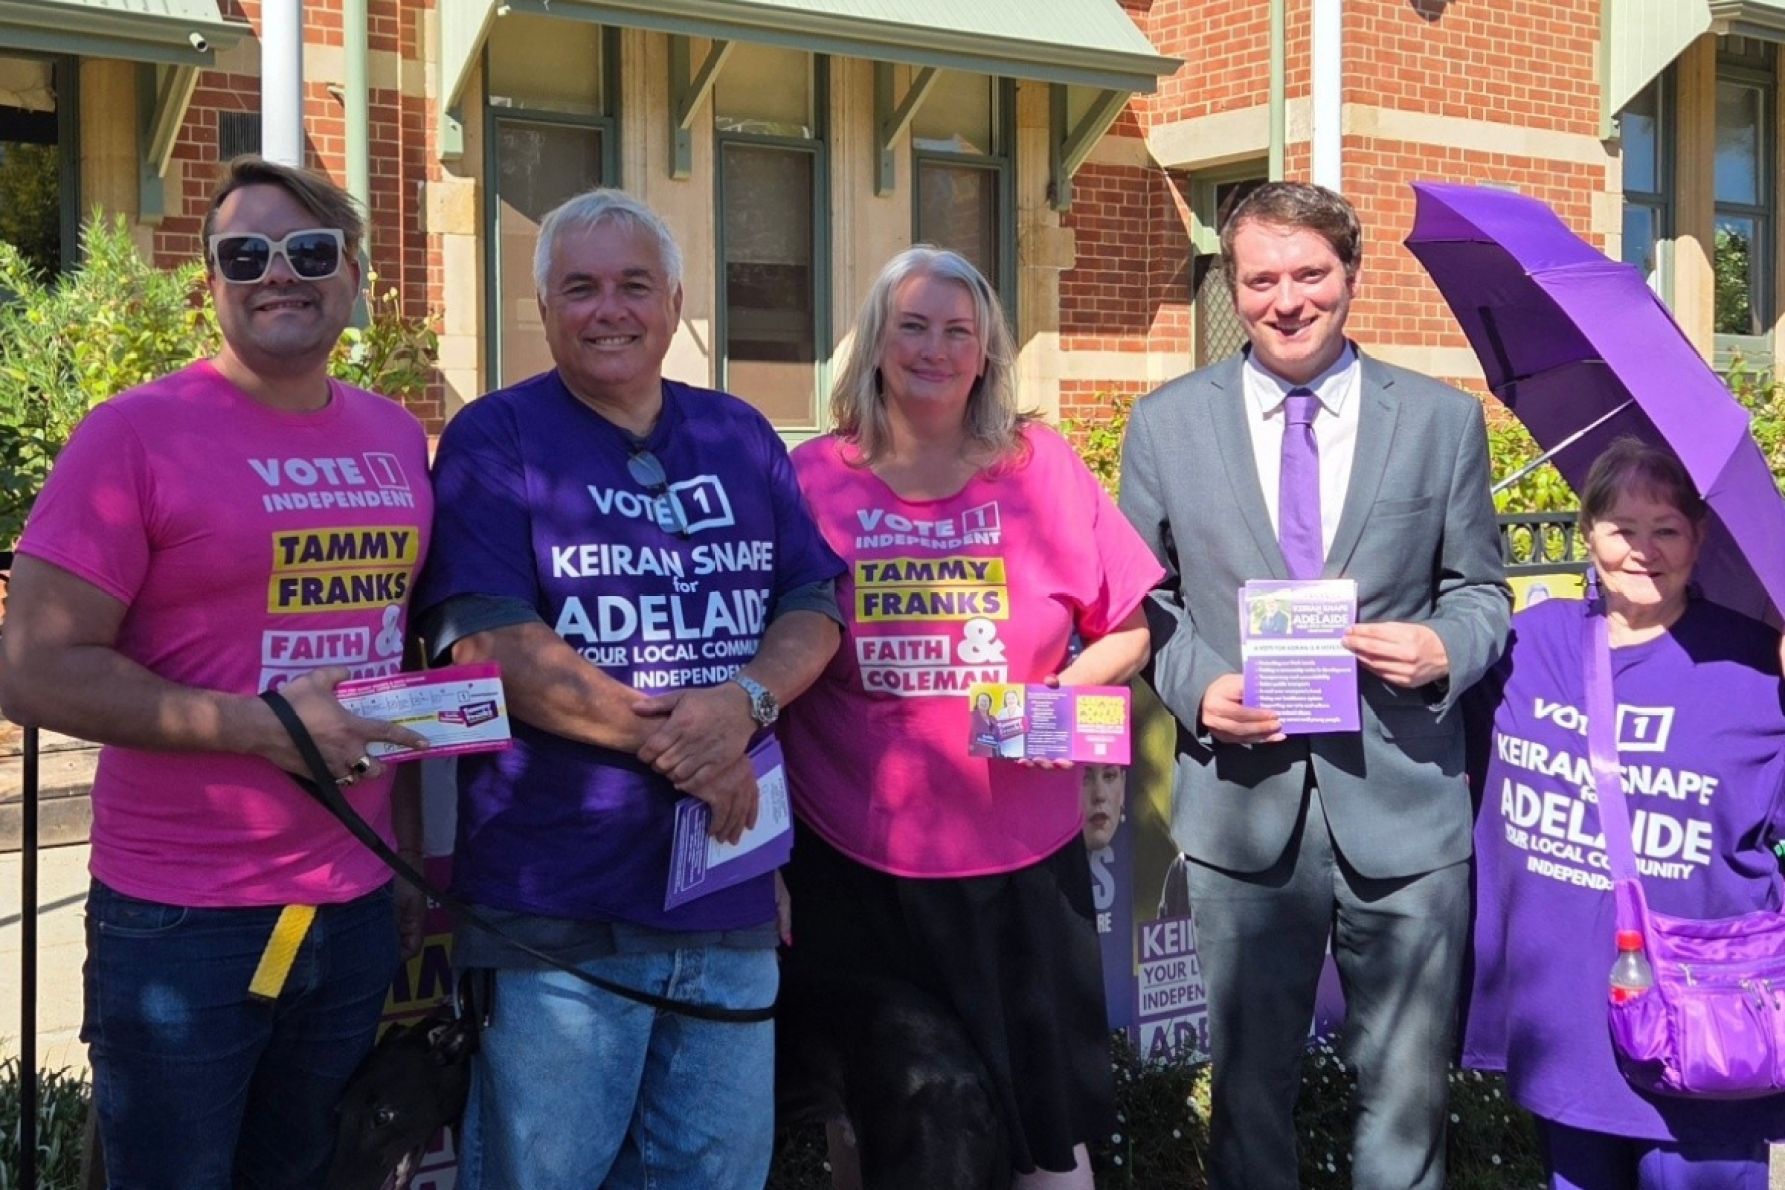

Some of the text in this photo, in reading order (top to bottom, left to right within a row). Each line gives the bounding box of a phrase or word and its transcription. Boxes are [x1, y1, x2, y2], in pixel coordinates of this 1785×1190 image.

[248, 457, 397, 486] VOTE 1
[262, 490, 415, 513] INDEPENDENT
[587, 485, 712, 525] VOTE 1
[856, 508, 956, 537] VOTE
[279, 531, 409, 565] TAMMY
[856, 531, 1001, 550] INDEPENDENT
[551, 541, 773, 578] KEIRAN SNAPE
[861, 560, 989, 582] TAMMY
[278, 572, 407, 607] FRANKS
[672, 575, 699, 593] for
[863, 591, 1001, 616] FRANKS
[270, 603, 404, 661] FAITH &
[862, 617, 1008, 664] FAITH &
[633, 642, 698, 663] LOCAL
[702, 639, 759, 658] COMMU
[633, 665, 741, 689] INDEPENDE
[867, 670, 999, 690] COLEMAN
[1534, 698, 1649, 738] VOT 1
[1497, 732, 1597, 790] KEIRAN
[1580, 785, 1598, 804] fo
[1530, 835, 1585, 864] LOCAL
[1587, 850, 1695, 880] COUNITY
[1527, 855, 1615, 891] INDEPEND
[1143, 960, 1186, 983] YOUR
[1143, 984, 1205, 1009] INDEPEN
